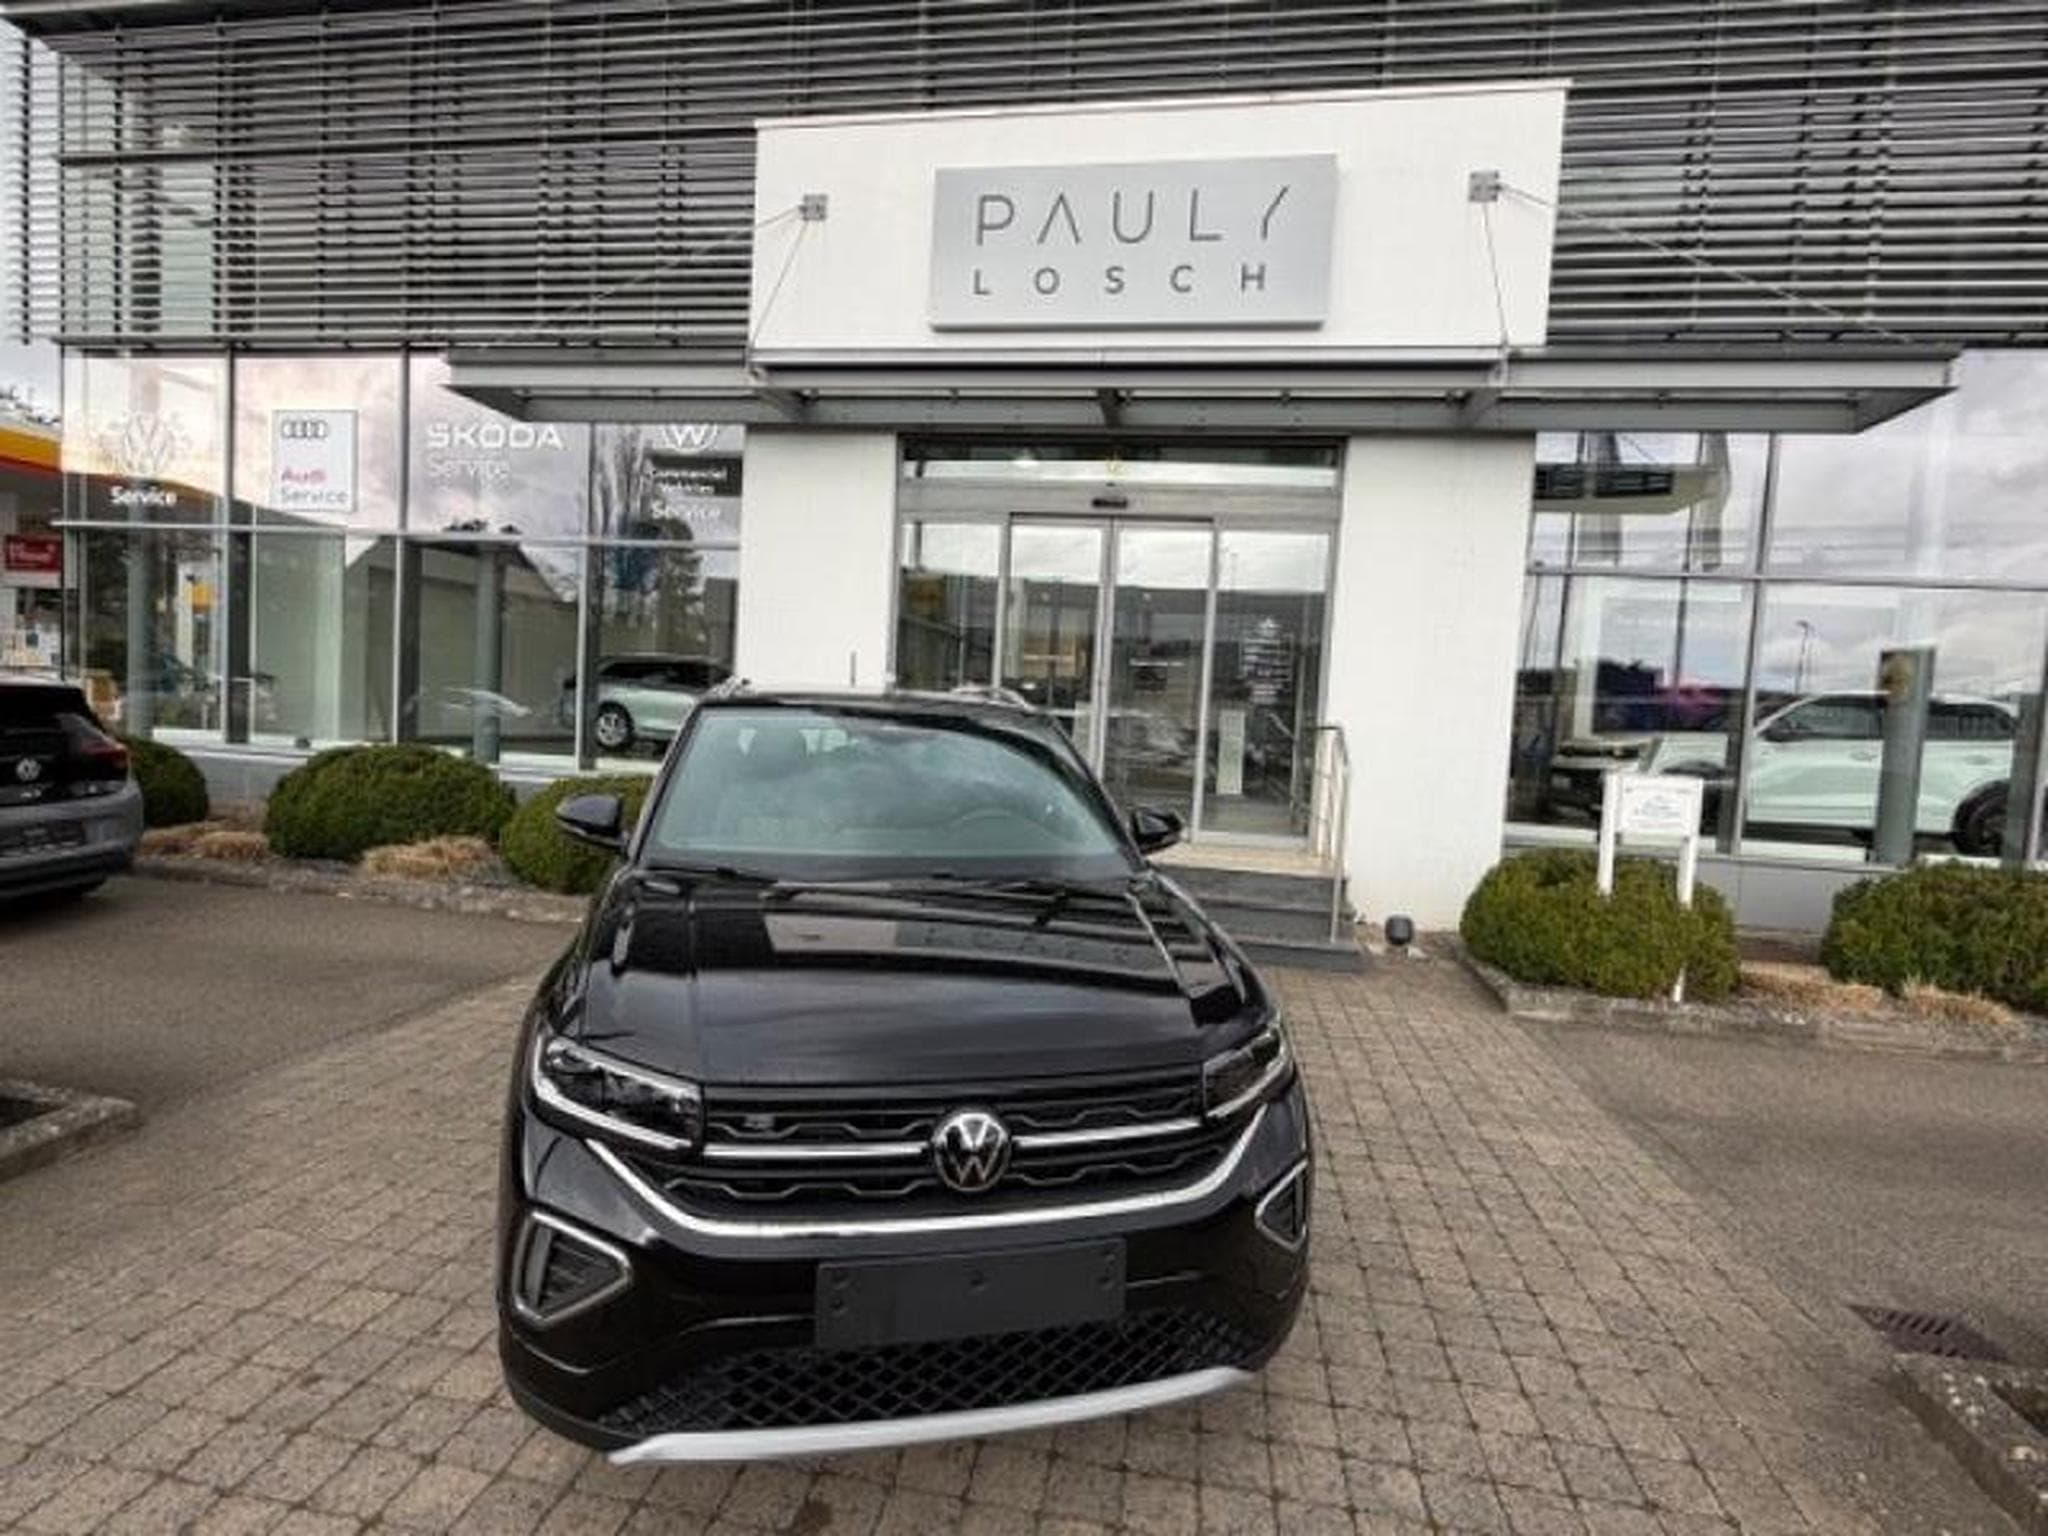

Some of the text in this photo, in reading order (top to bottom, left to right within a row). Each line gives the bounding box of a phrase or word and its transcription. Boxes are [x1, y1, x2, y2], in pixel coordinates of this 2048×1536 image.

[976, 185, 1290, 246] PAULY
[973, 263, 1268, 296] LOSCH
[110, 485, 178, 506] Service
[281, 487, 350, 504] Service
